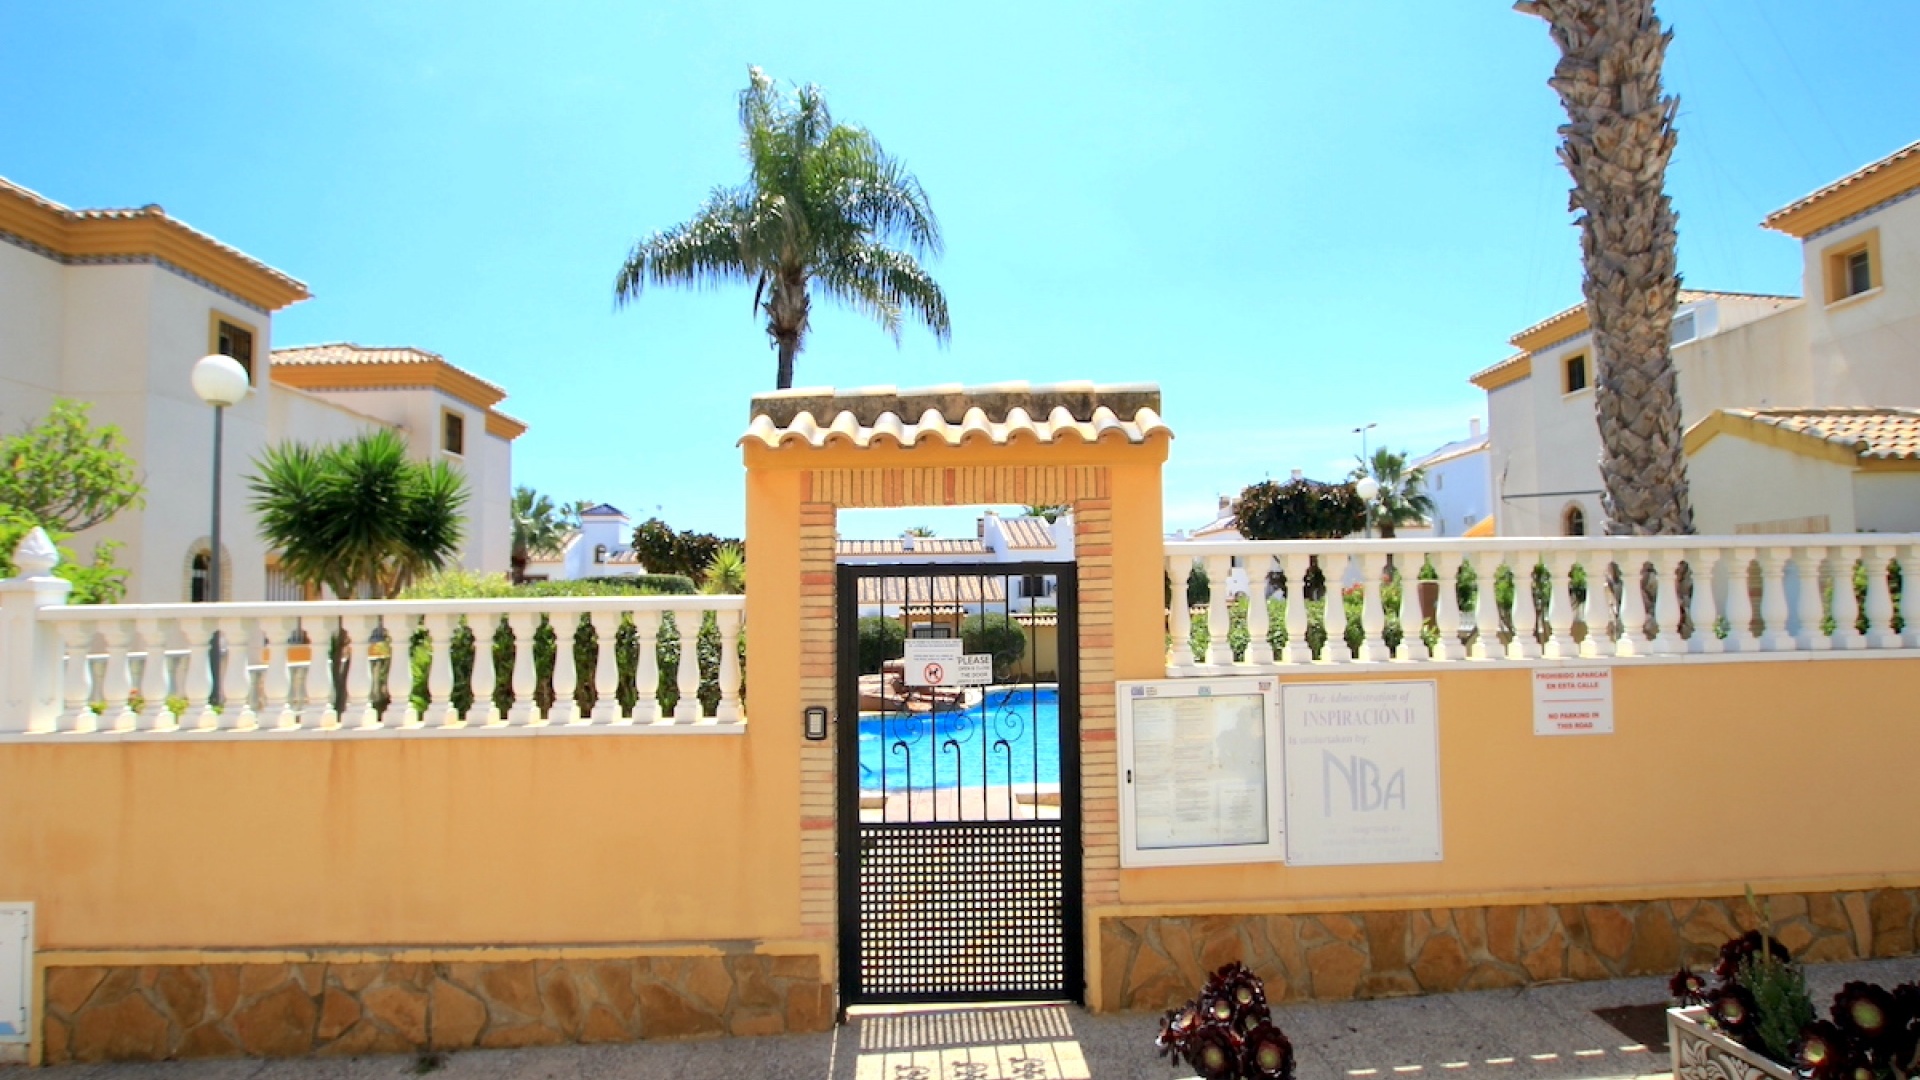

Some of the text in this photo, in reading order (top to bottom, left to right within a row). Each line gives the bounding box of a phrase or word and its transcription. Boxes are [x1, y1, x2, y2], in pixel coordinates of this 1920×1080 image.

[957, 656, 989, 665] PLEASE
[1307, 690, 1411, 704] The Administration of
[1303, 703, 1416, 727] INSPIRACIÓN II
[1548, 712, 1559, 720] NO
[1299, 735, 1353, 744] undertaken
[1322, 749, 1406, 818] NBA
